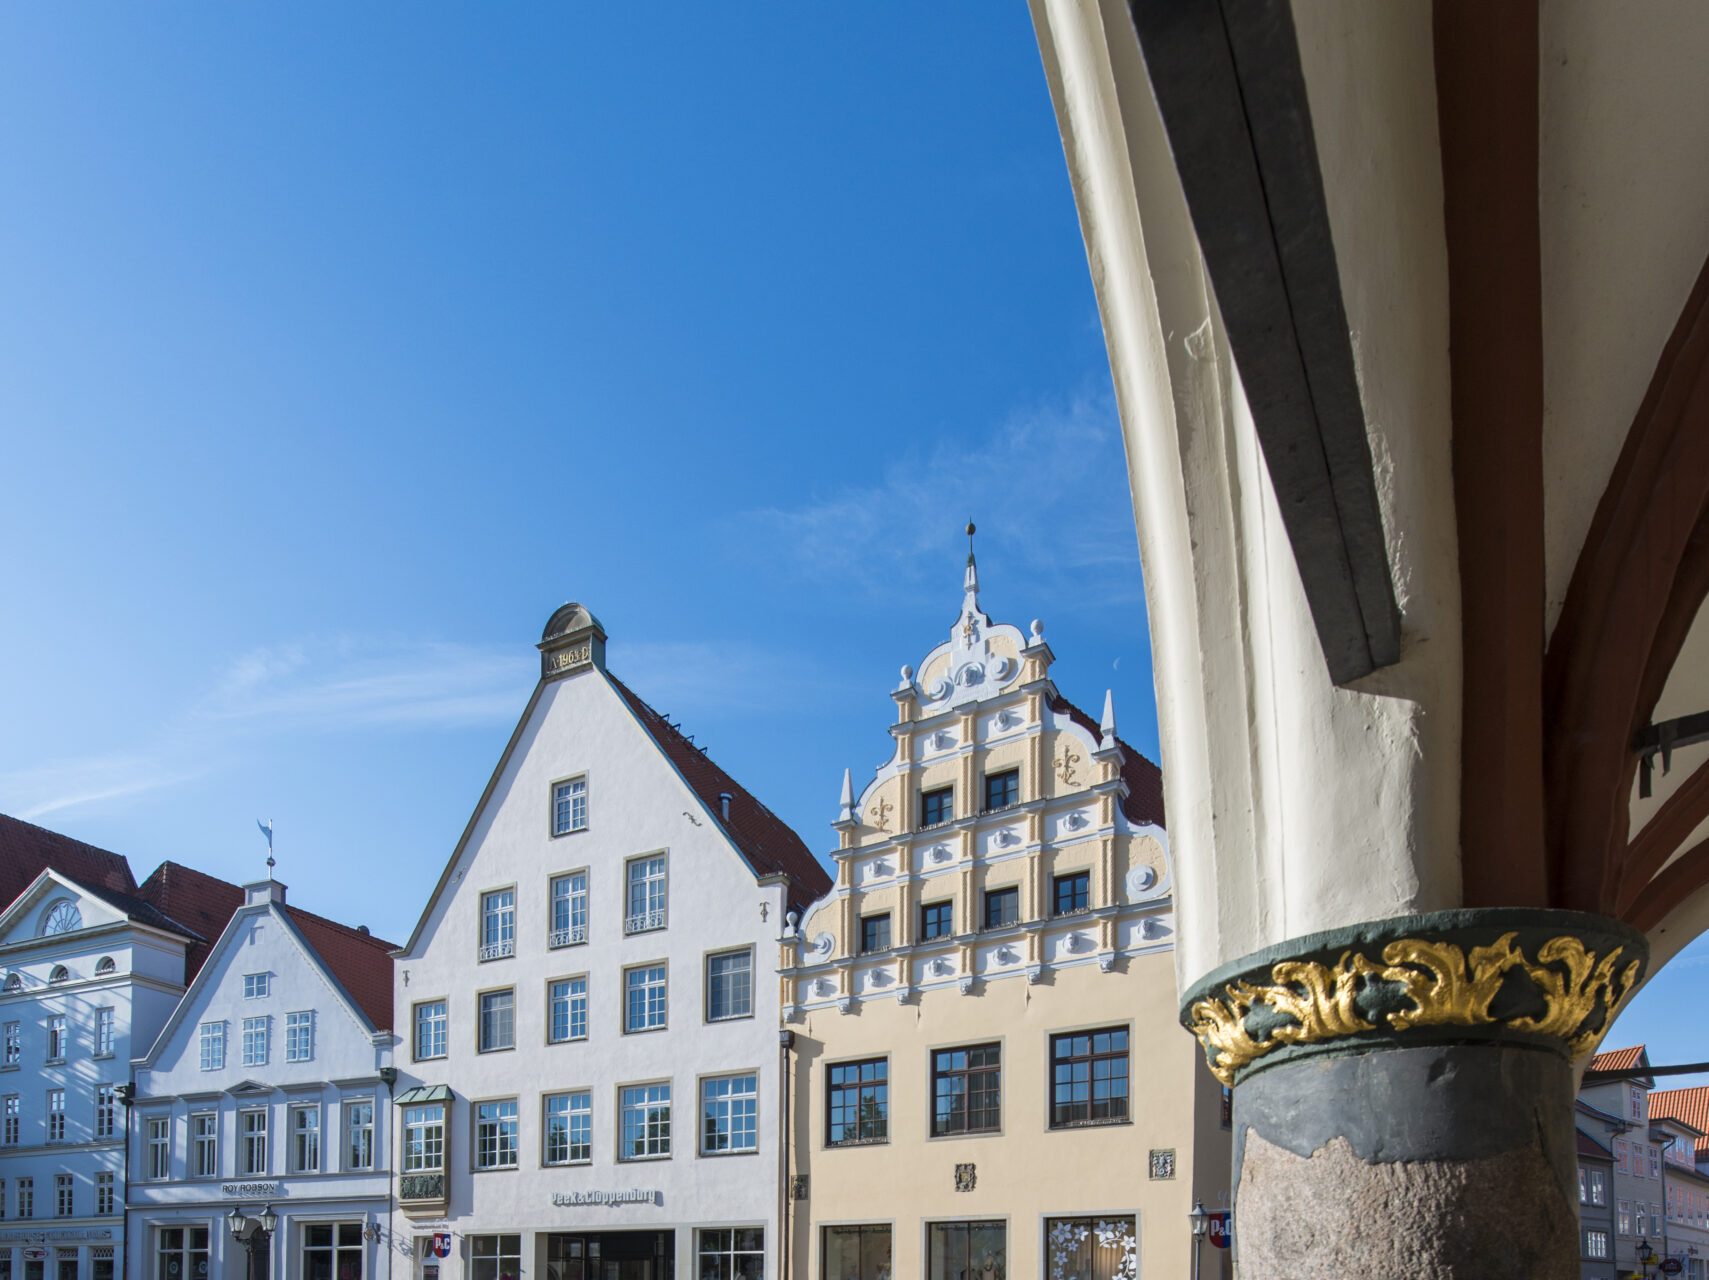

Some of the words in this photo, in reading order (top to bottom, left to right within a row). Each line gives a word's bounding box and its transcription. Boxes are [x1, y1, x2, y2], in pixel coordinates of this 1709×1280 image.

[222, 1184, 238, 1193] ROY
[240, 1183, 275, 1192] ROBSON
[435, 1237, 450, 1250] P&C
